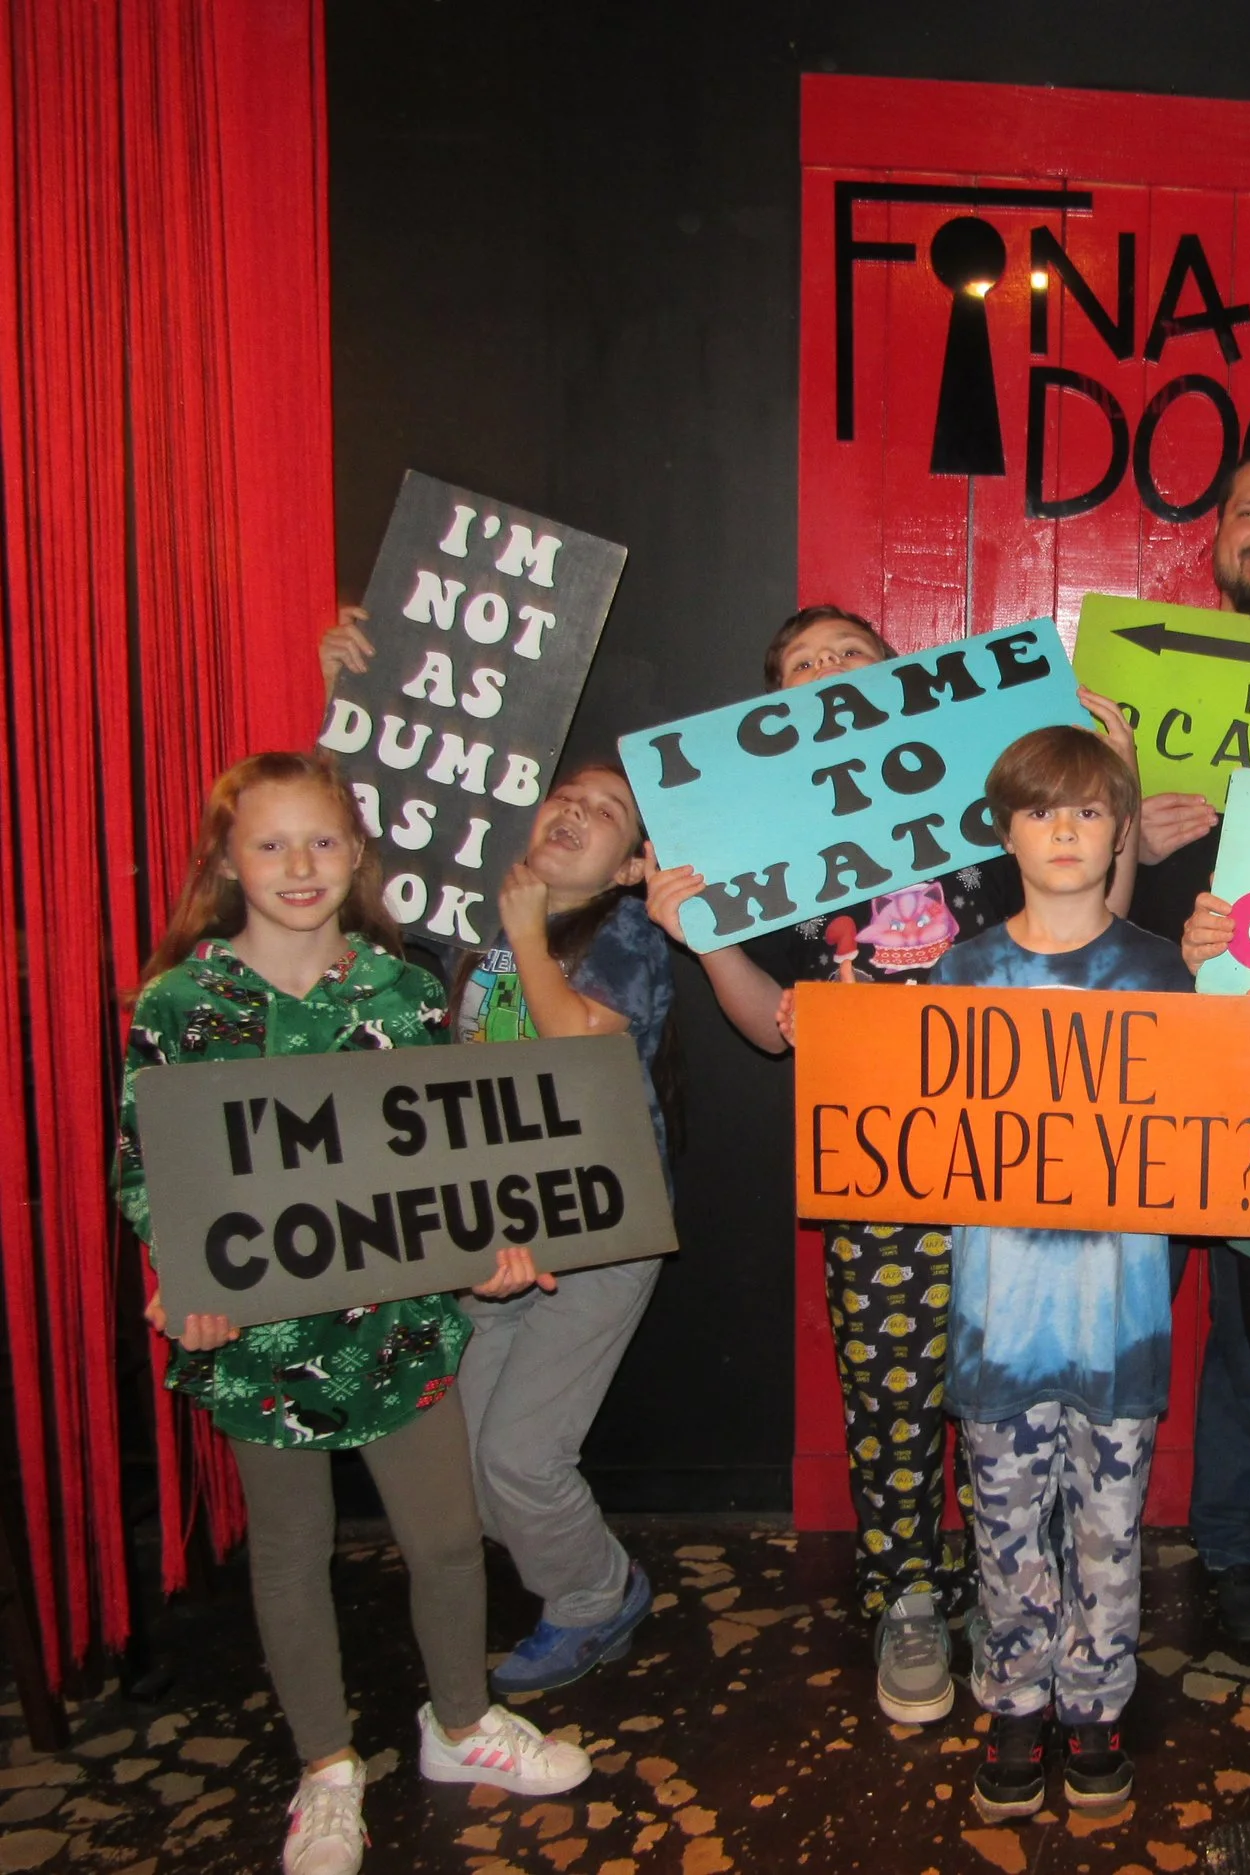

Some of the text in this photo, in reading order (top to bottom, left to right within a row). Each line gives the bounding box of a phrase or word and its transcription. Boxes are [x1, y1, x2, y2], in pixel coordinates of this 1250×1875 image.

[439, 504, 562, 588] I'M
[403, 570, 556, 660] NOT
[402, 651, 506, 719] AS
[649, 631, 1051, 789] I CAME
[318, 699, 541, 807] DUMB
[811, 742, 946, 817] TO
[455, 818, 491, 869] I
[703, 796, 1002, 937] WATC
[383, 873, 481, 944] OK
[920, 1004, 1158, 1104] DID WE
[223, 1073, 582, 1176] I'M STILL
[812, 1104, 1075, 1205] ESCAPE
[205, 1164, 624, 1291] CONFUSED
